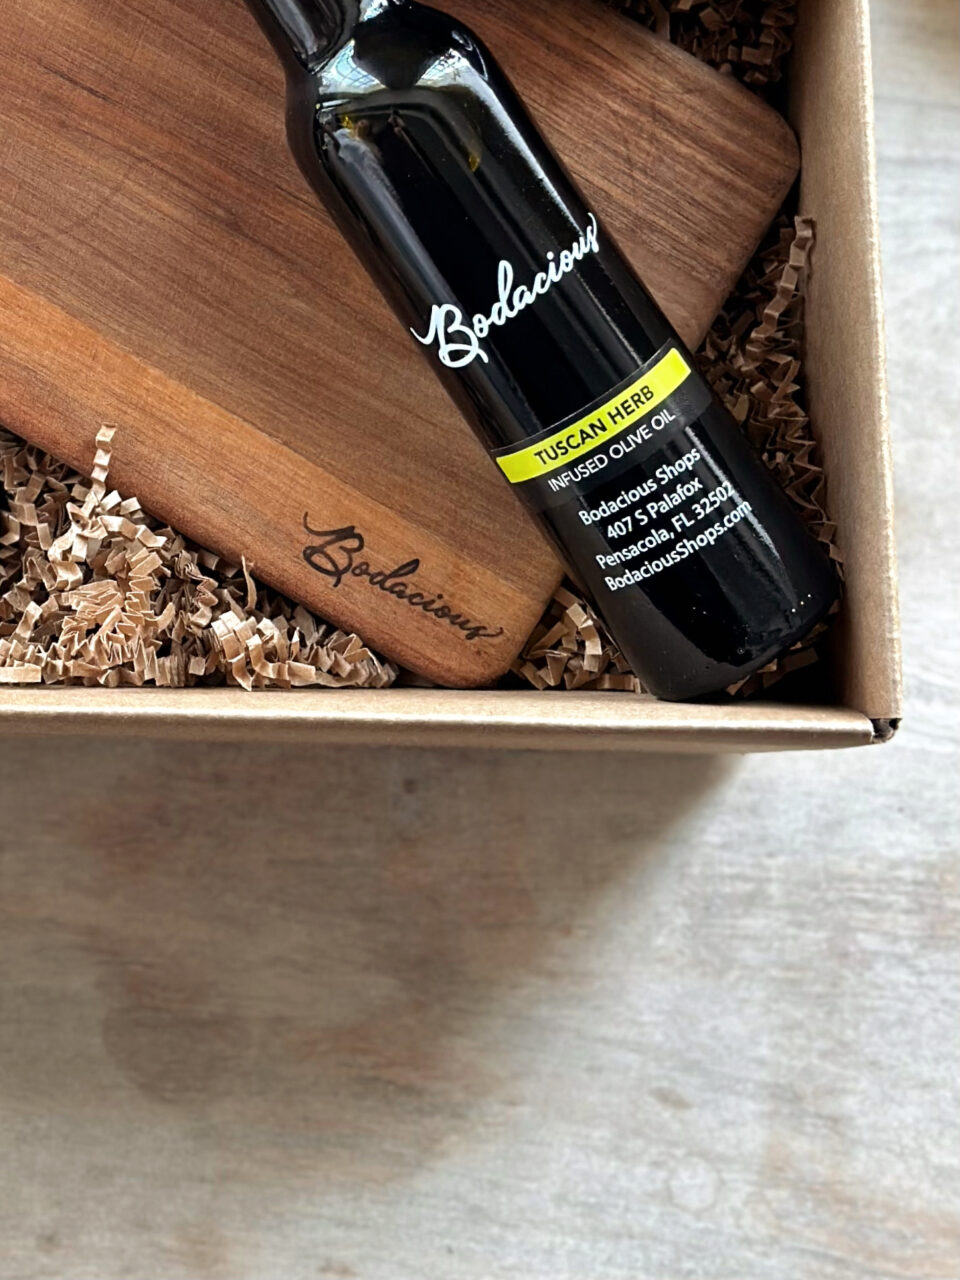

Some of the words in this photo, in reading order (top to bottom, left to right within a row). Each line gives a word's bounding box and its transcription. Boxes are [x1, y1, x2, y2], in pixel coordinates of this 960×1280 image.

[410, 212, 600, 368] Bodacious
[533, 418, 608, 466] TUSCAN
[607, 385, 655, 425] HERB
[547, 453, 609, 493] INFUSED
[609, 424, 654, 460] OLIVE
[650, 409, 677, 431] OIL
[578, 478, 658, 526] Bodacious
[655, 448, 702, 485] Shops
[595, 528, 675, 570] Pensacola,
[671, 512, 695, 533] FL
[691, 480, 736, 520] 32502
[606, 516, 632, 540] 407
[634, 509, 649, 526] S
[646, 477, 704, 519] Palafox
[302, 511, 504, 641] Bodacious
[604, 501, 753, 592] BodaciousShops.com
